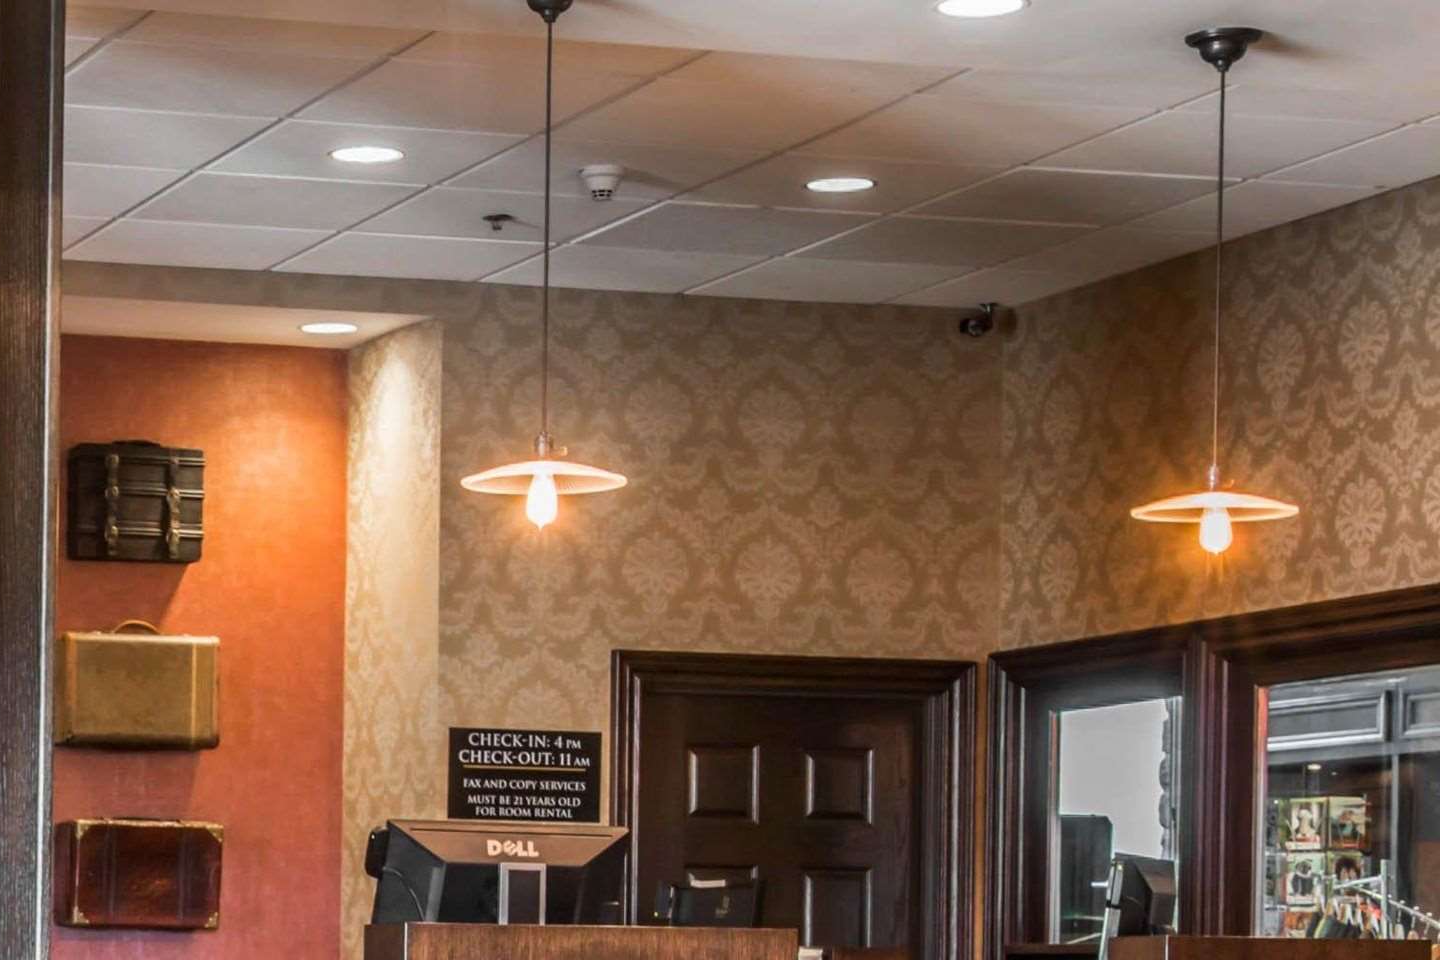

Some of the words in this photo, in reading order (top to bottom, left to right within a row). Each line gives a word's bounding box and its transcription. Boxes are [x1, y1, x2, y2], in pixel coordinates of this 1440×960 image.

[468, 732, 551, 748] CHECK-IN:
[553, 735, 563, 749] 4
[565, 739, 582, 750] PM
[458, 749, 555, 765] CHECK-OUT:
[559, 753, 571, 766] 11
[573, 757, 591, 767] AM
[463, 778, 482, 789] FAX
[483, 779, 507, 790] AND
[509, 780, 538, 791] COPY
[539, 781, 587, 792] SERVICES
[467, 795, 496, 806] MUST
[499, 795, 512, 806] BE
[513, 796, 524, 806] 21
[525, 796, 557, 807] YEARS
[558, 797, 582, 807] OLD
[475, 806, 497, 817] FOR
[499, 807, 532, 817] ROOM
[534, 808, 574, 819] RENTAL
[486, 839, 540, 858] DELL
